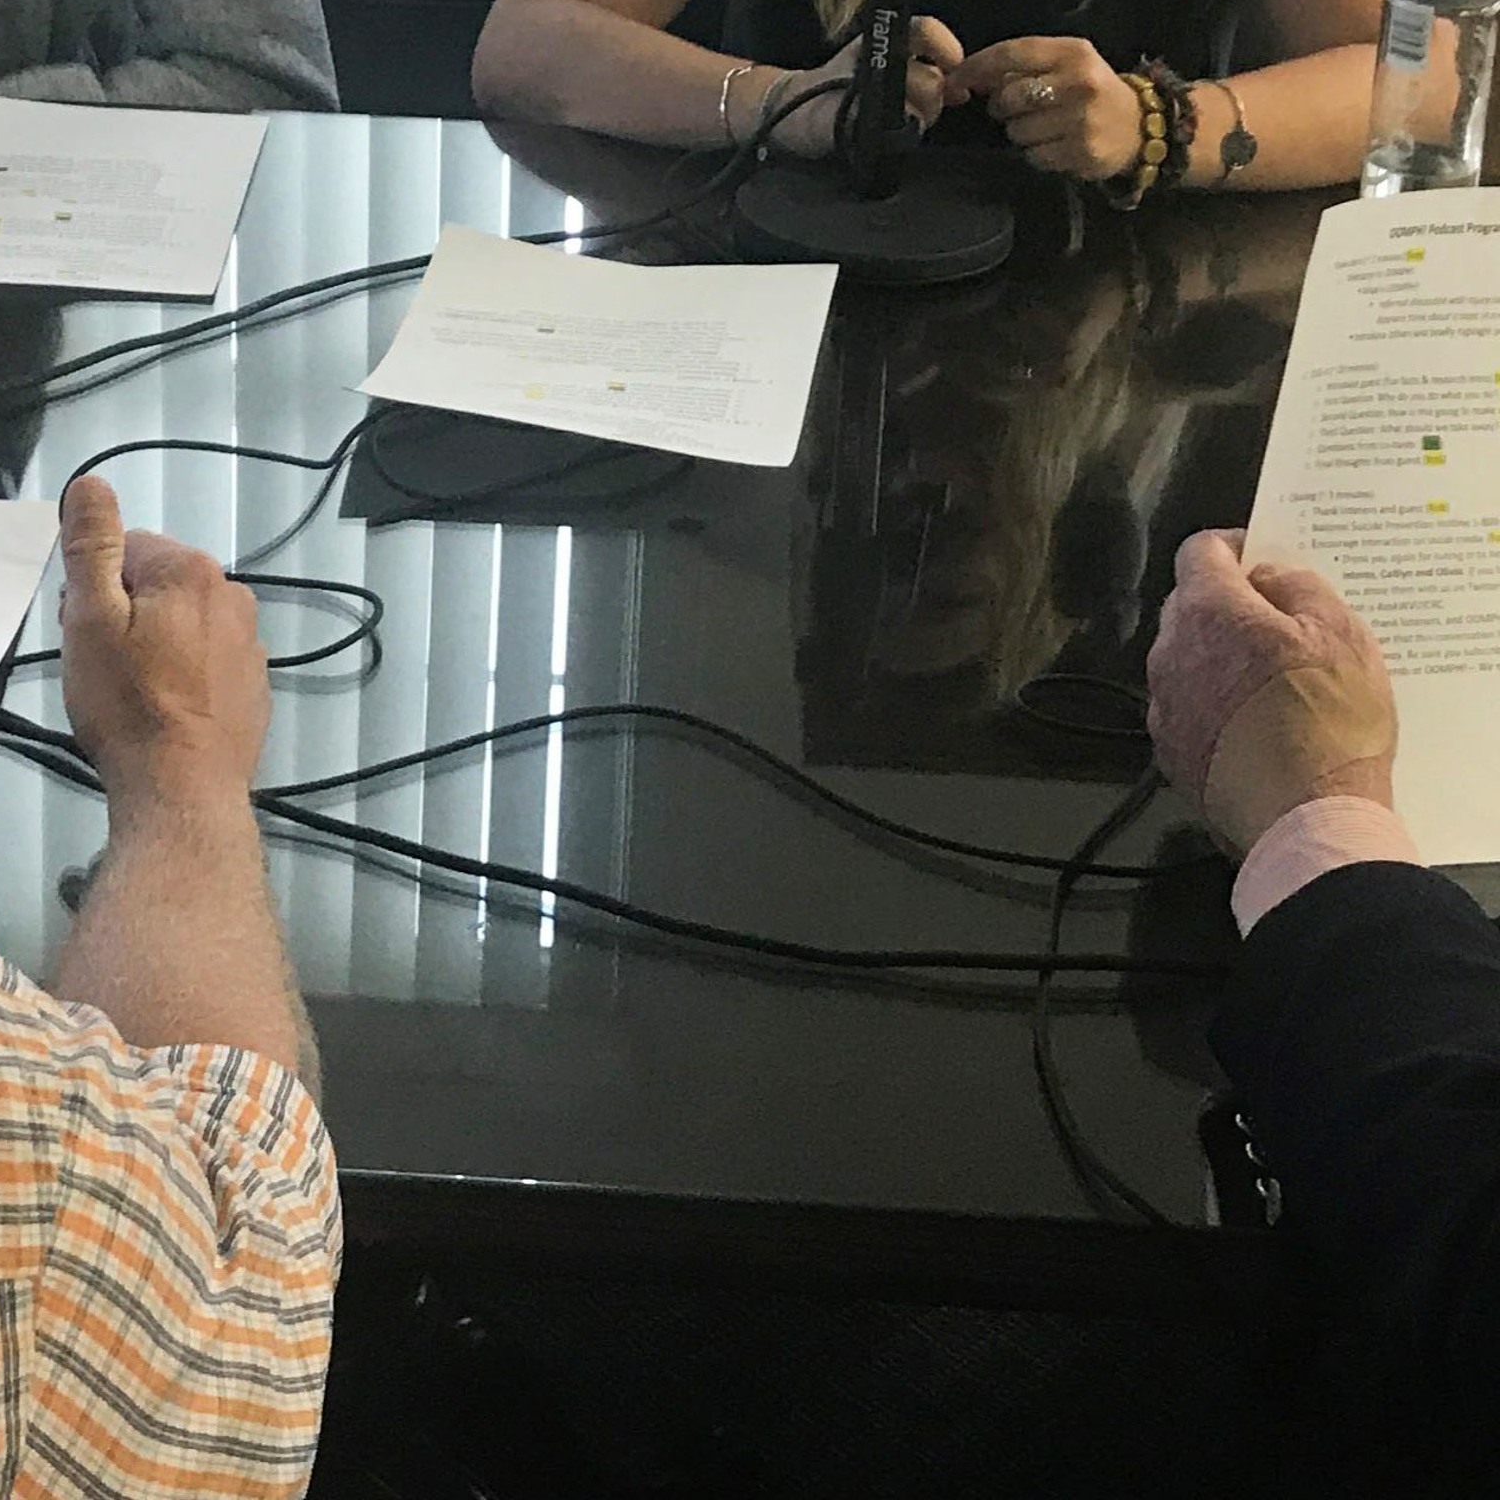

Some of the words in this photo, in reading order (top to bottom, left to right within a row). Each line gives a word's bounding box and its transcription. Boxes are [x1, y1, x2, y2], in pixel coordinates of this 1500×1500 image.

[871, 8, 898, 70] frame
[1428, 223, 1465, 235] Podcast
[1415, 568, 1433, 578] and
